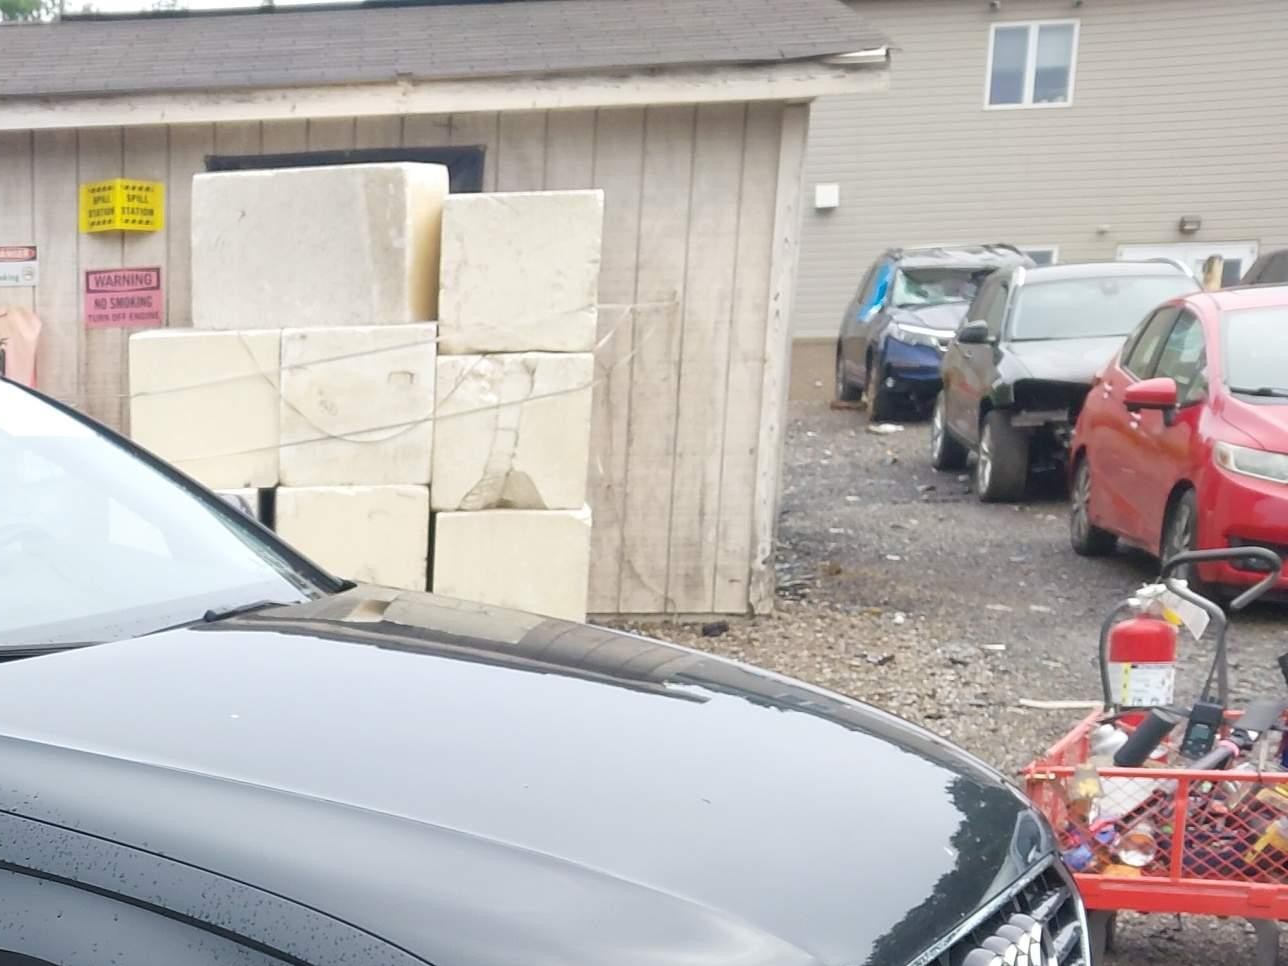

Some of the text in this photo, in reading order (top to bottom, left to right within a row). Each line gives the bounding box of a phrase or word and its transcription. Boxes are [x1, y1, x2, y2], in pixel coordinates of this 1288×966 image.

[93, 195, 110, 205] SPILL
[127, 193, 149, 204] SPILL
[88, 207, 115, 218] STATION
[121, 206, 154, 217] STATION
[93, 273, 153, 289] WARNING
[94, 295, 153, 310] NO SMOKING
[88, 311, 159, 322] TURN OFF ENGINE
